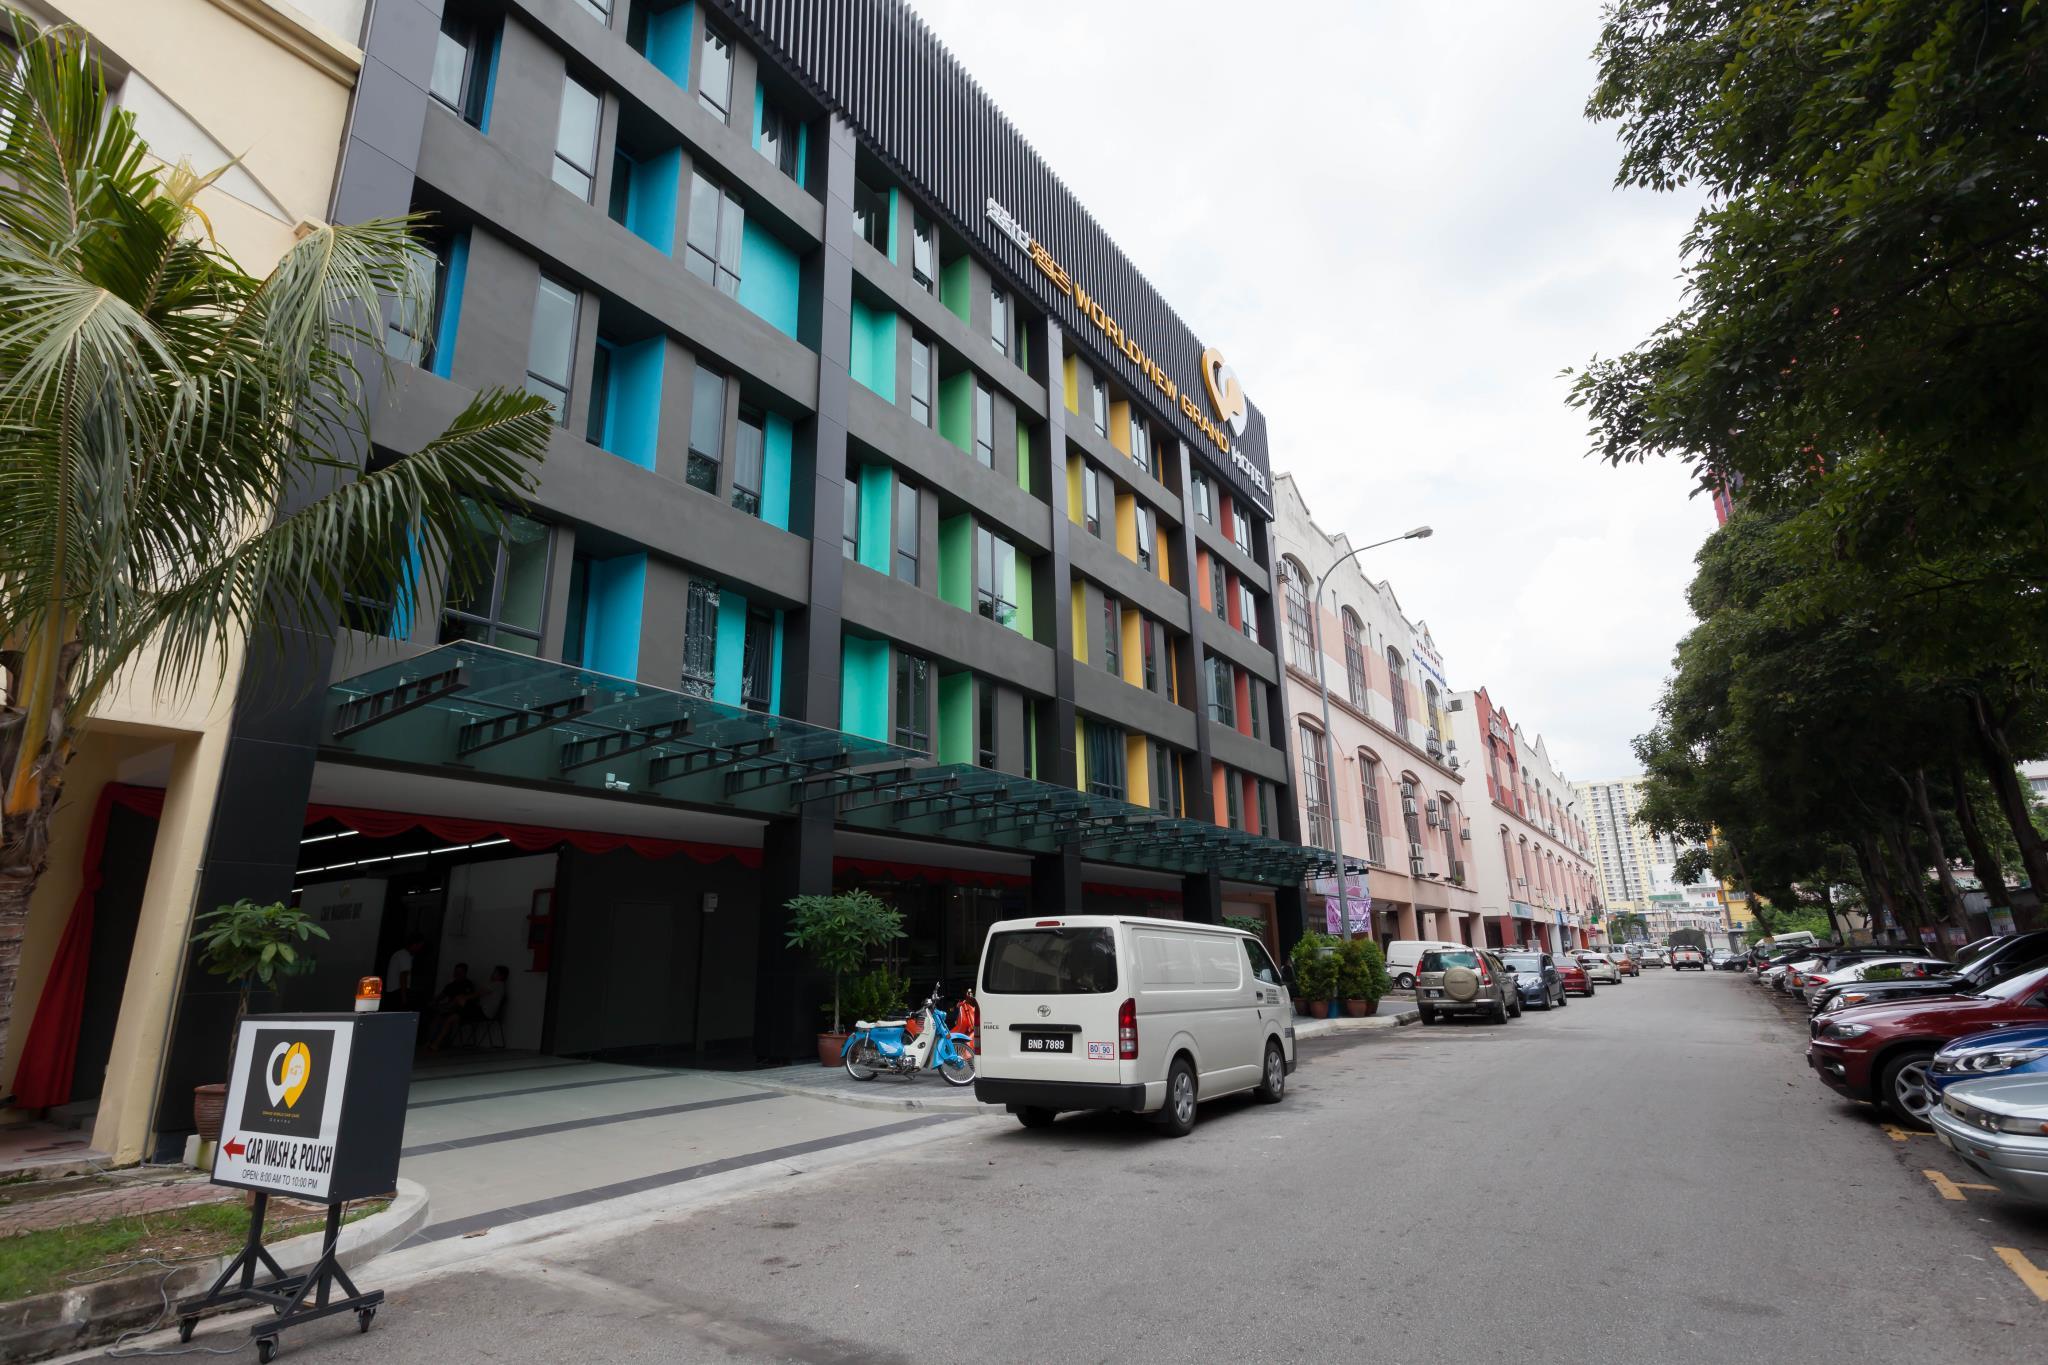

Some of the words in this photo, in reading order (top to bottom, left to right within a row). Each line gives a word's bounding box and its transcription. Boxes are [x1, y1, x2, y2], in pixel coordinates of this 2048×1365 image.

[1074, 282, 1178, 403] WORLDVIEW
[1180, 393, 1229, 454] GRAND
[1232, 447, 1269, 496] HOTEL
[1028, 1039, 1043, 1049] BNB
[1045, 1040, 1065, 1049] 7889
[1089, 1044, 1099, 1053] 80
[1102, 1046, 1111, 1054] 90
[246, 1138, 263, 1164] CAR
[264, 1139, 291, 1168] WASH
[290, 1143, 298, 1169] &
[299, 1144, 333, 1174] POLISH
[242, 1169, 259, 1179] OPEN:
[260, 1171, 271, 1182] 8:00
[271, 1174, 282, 1183] AM
[282, 1175, 291, 1185] TO
[292, 1177, 307, 1188] 10:00
[308, 1178, 318, 1188] PM
